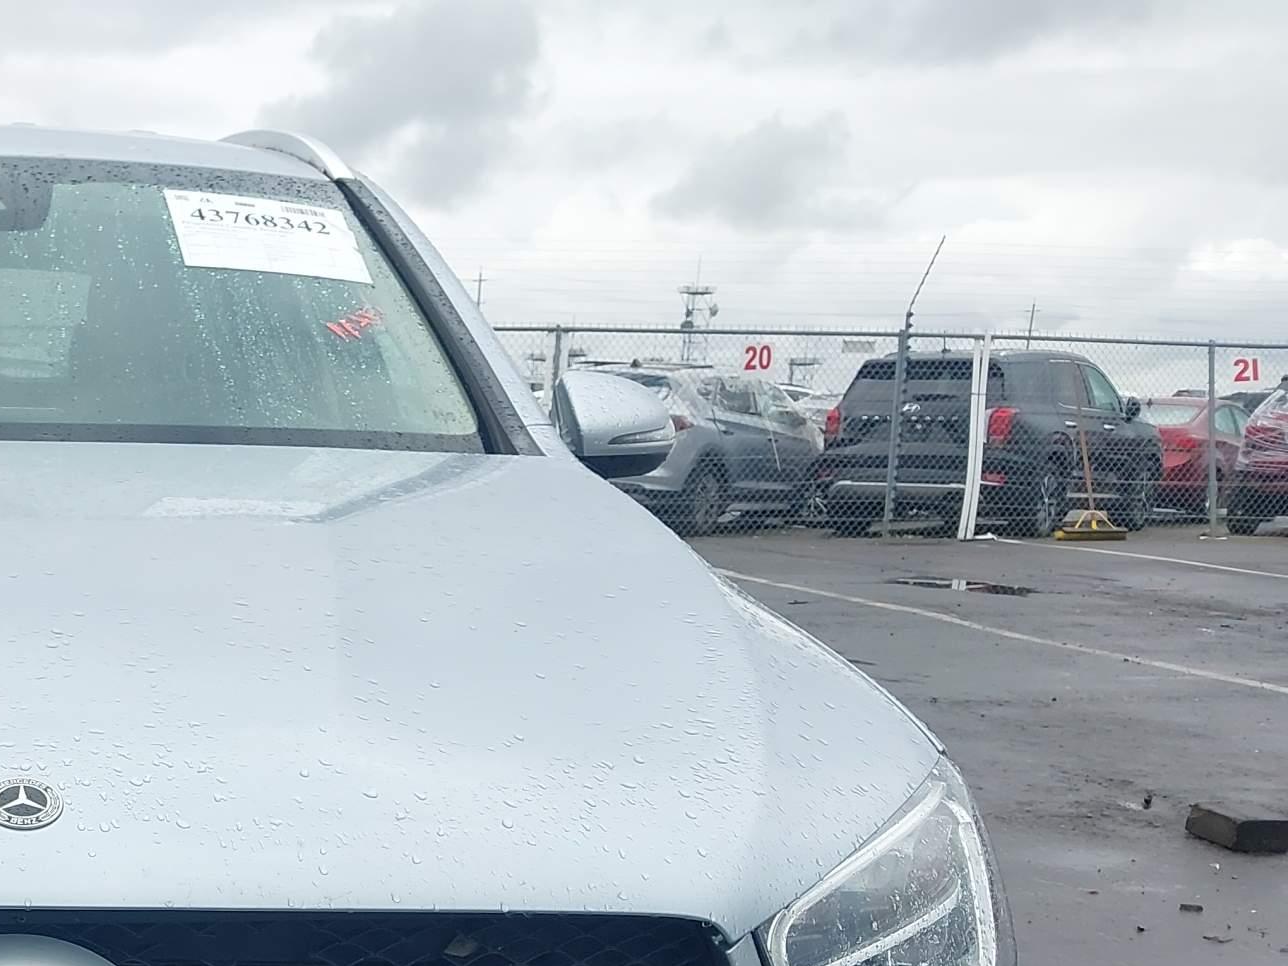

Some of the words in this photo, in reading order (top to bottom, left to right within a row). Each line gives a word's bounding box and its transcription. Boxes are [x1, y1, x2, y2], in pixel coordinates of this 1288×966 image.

[190, 208, 330, 235] 43768342
[744, 345, 772, 370] 20
[1233, 358, 1259, 382] 21
